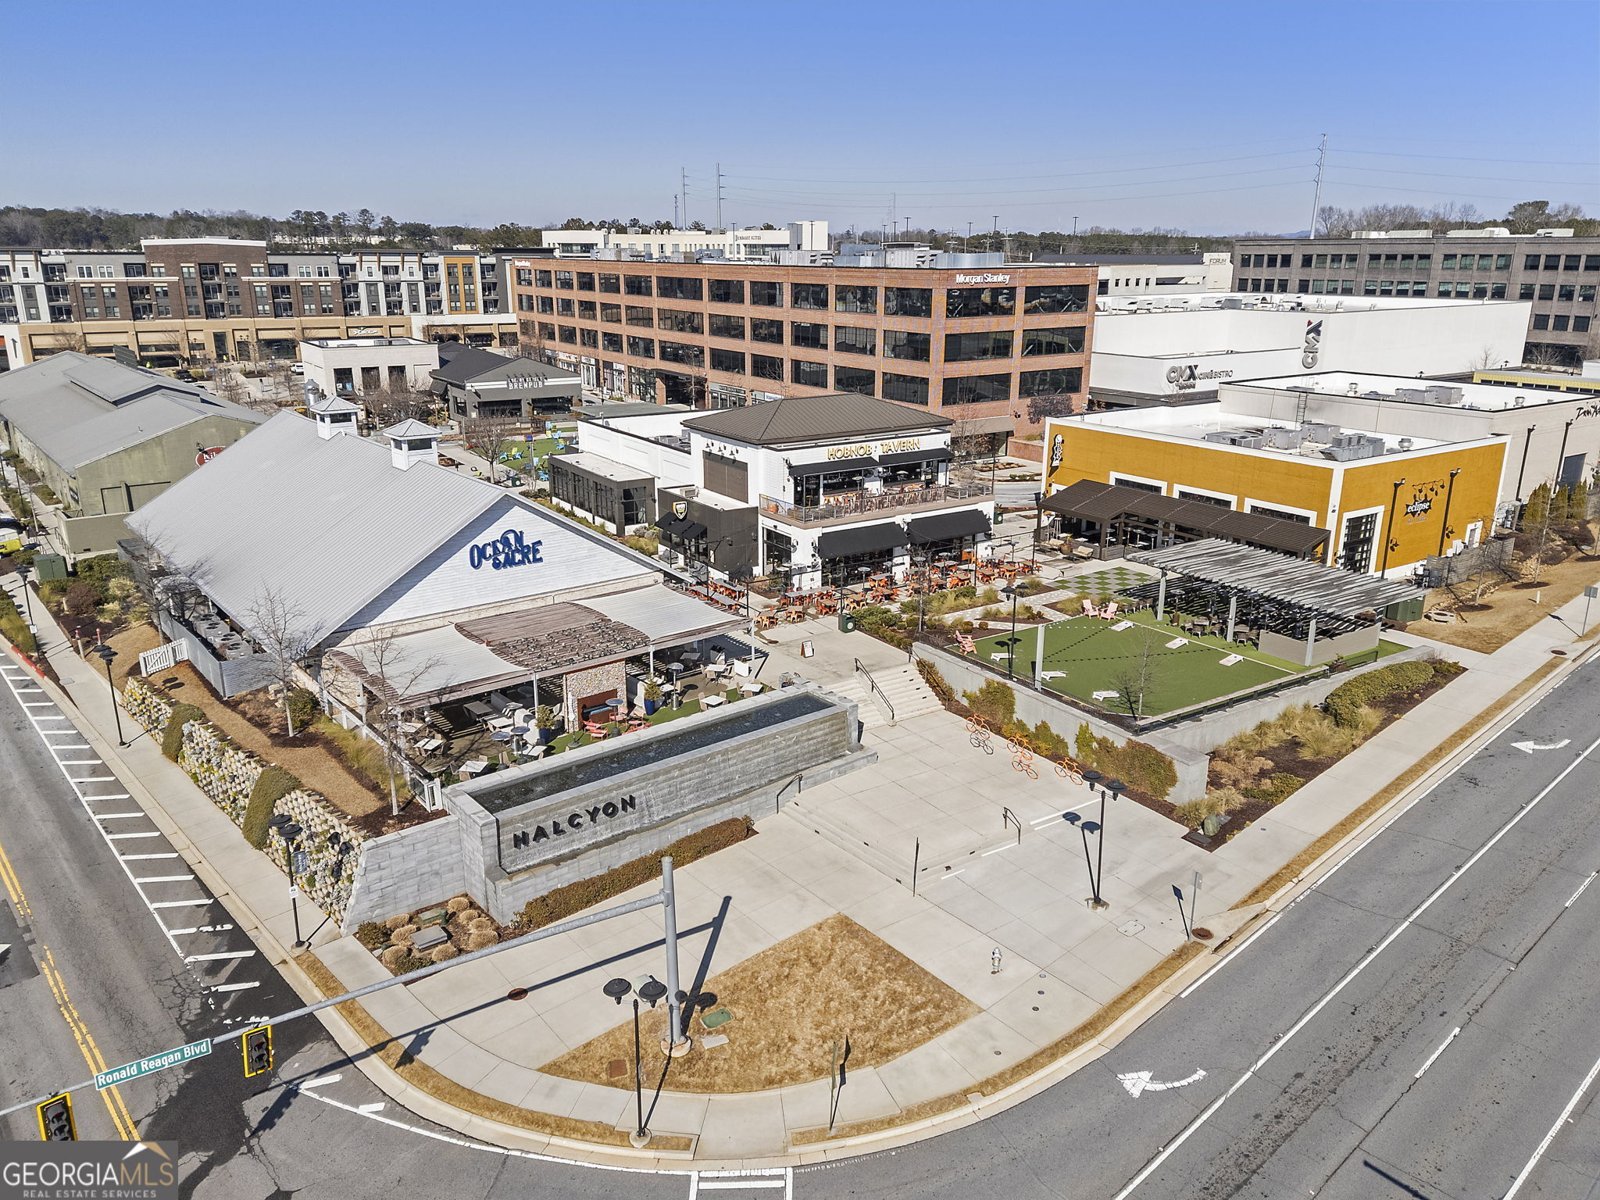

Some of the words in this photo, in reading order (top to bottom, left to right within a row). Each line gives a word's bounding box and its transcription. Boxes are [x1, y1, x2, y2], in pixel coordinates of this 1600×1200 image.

[956, 273, 983, 286] Morgan
[983, 272, 1010, 285] Stanley
[1302, 319, 1323, 369] CMX
[1166, 364, 1198, 384] CMX
[508, 381, 543, 390] BREWPUB
[827, 444, 873, 460] HOBNOB
[880, 438, 921, 454] TAVERN
[513, 794, 636, 850] HALCYON
[97, 1064, 138, 1086] Ronald
[141, 1051, 182, 1072] Reagan
[183, 1041, 208, 1058] Blvd
